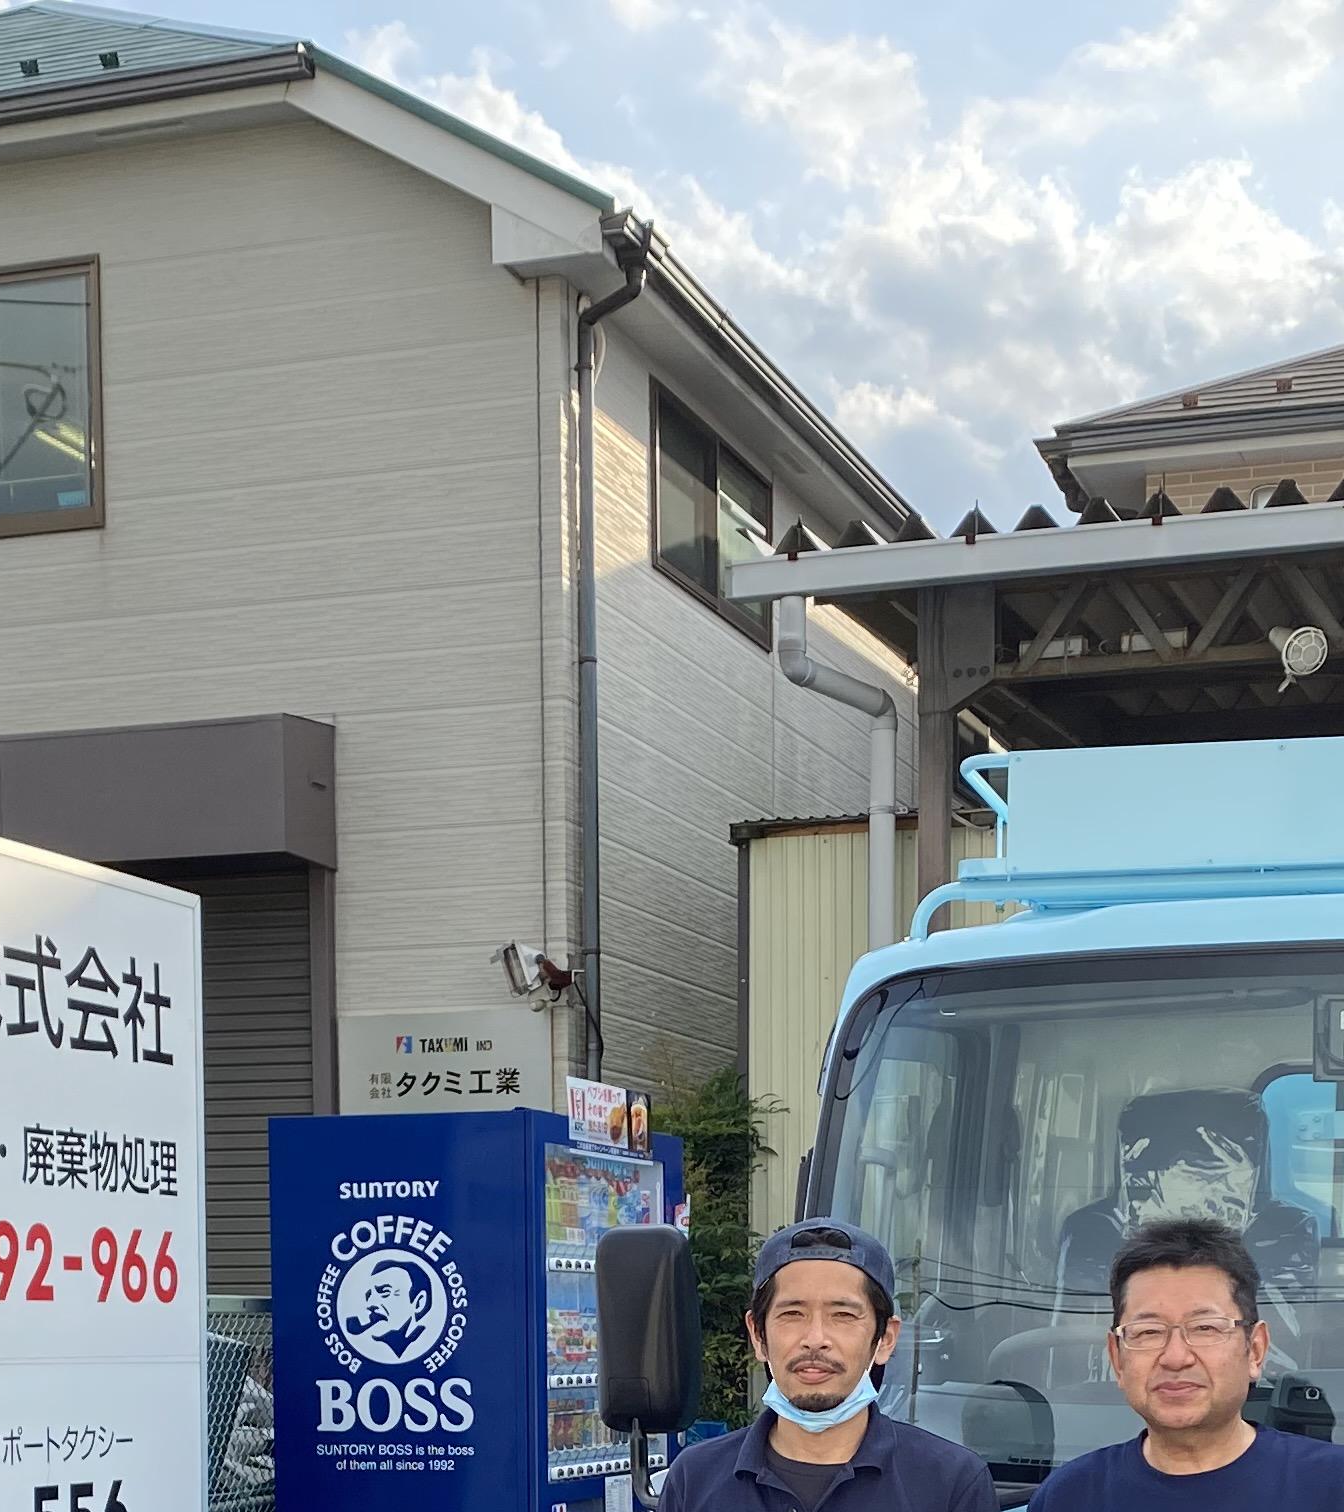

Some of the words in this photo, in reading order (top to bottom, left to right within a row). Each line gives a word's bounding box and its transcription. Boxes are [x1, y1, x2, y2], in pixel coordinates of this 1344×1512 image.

[369, 1073, 392, 1085] 有限
[369, 1087, 392, 1099] 会社
[396, 1067, 521, 1097] タクミ工業
[331, 1214, 453, 1262] COFFEE
[316, 1263, 341, 1331] COFFEE
[441, 1261, 468, 1309] BOSS
[324, 1333, 363, 1374] BOSS
[423, 1312, 467, 1374] COFFEE
[315, 1377, 474, 1433] BOSS
[316, 1444, 375, 1456] SUNTORY
[378, 1444, 413, 1456] BOSS
[416, 1444, 425, 1456] is
[427, 1444, 445, 1456] the
[447, 1444, 475, 1456] boss
[336, 1459, 347, 1471] of
[349, 1459, 377, 1471] them
[380, 1459, 393, 1471] all
[395, 1459, 425, 1471] since
[428, 1459, 455, 1471] 1992
